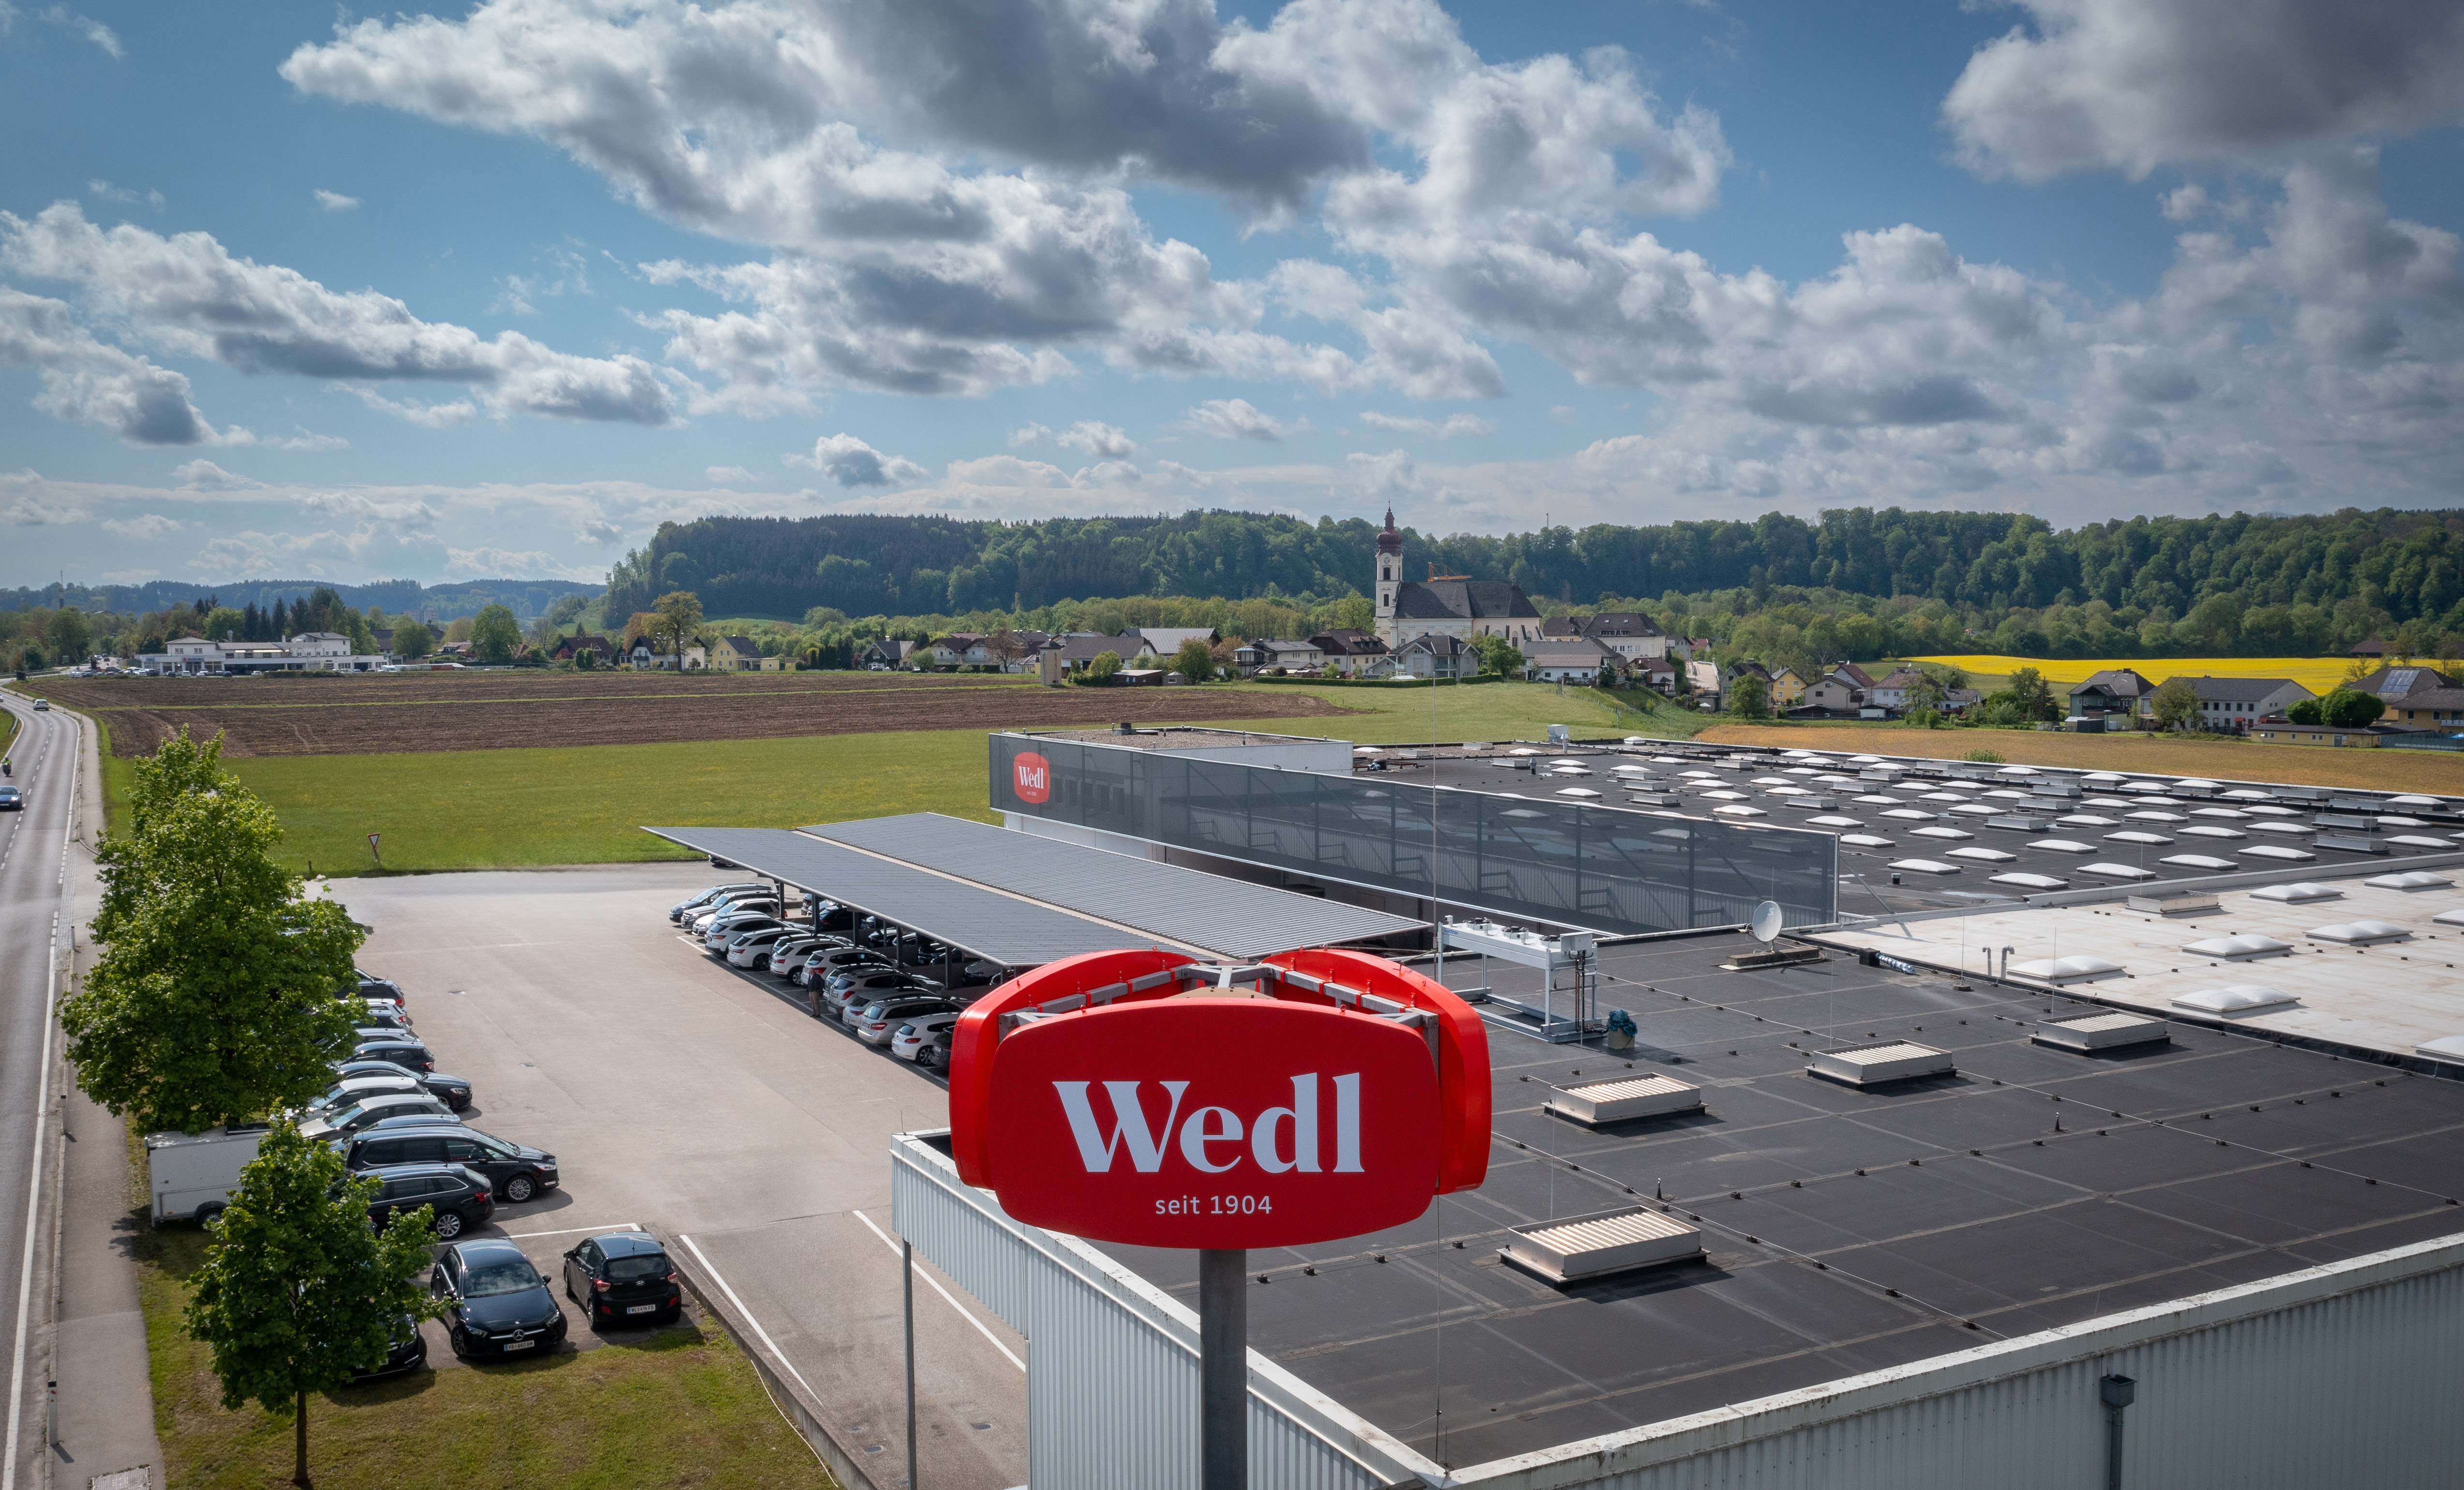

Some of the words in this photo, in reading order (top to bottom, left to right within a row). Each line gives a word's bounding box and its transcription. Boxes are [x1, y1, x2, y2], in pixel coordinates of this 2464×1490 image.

[1018, 766, 1044, 789] Wedl
[1052, 1072, 1365, 1173] Wedl
[1155, 1195, 1200, 1214] seit
[1210, 1195, 1272, 1214] 1904
